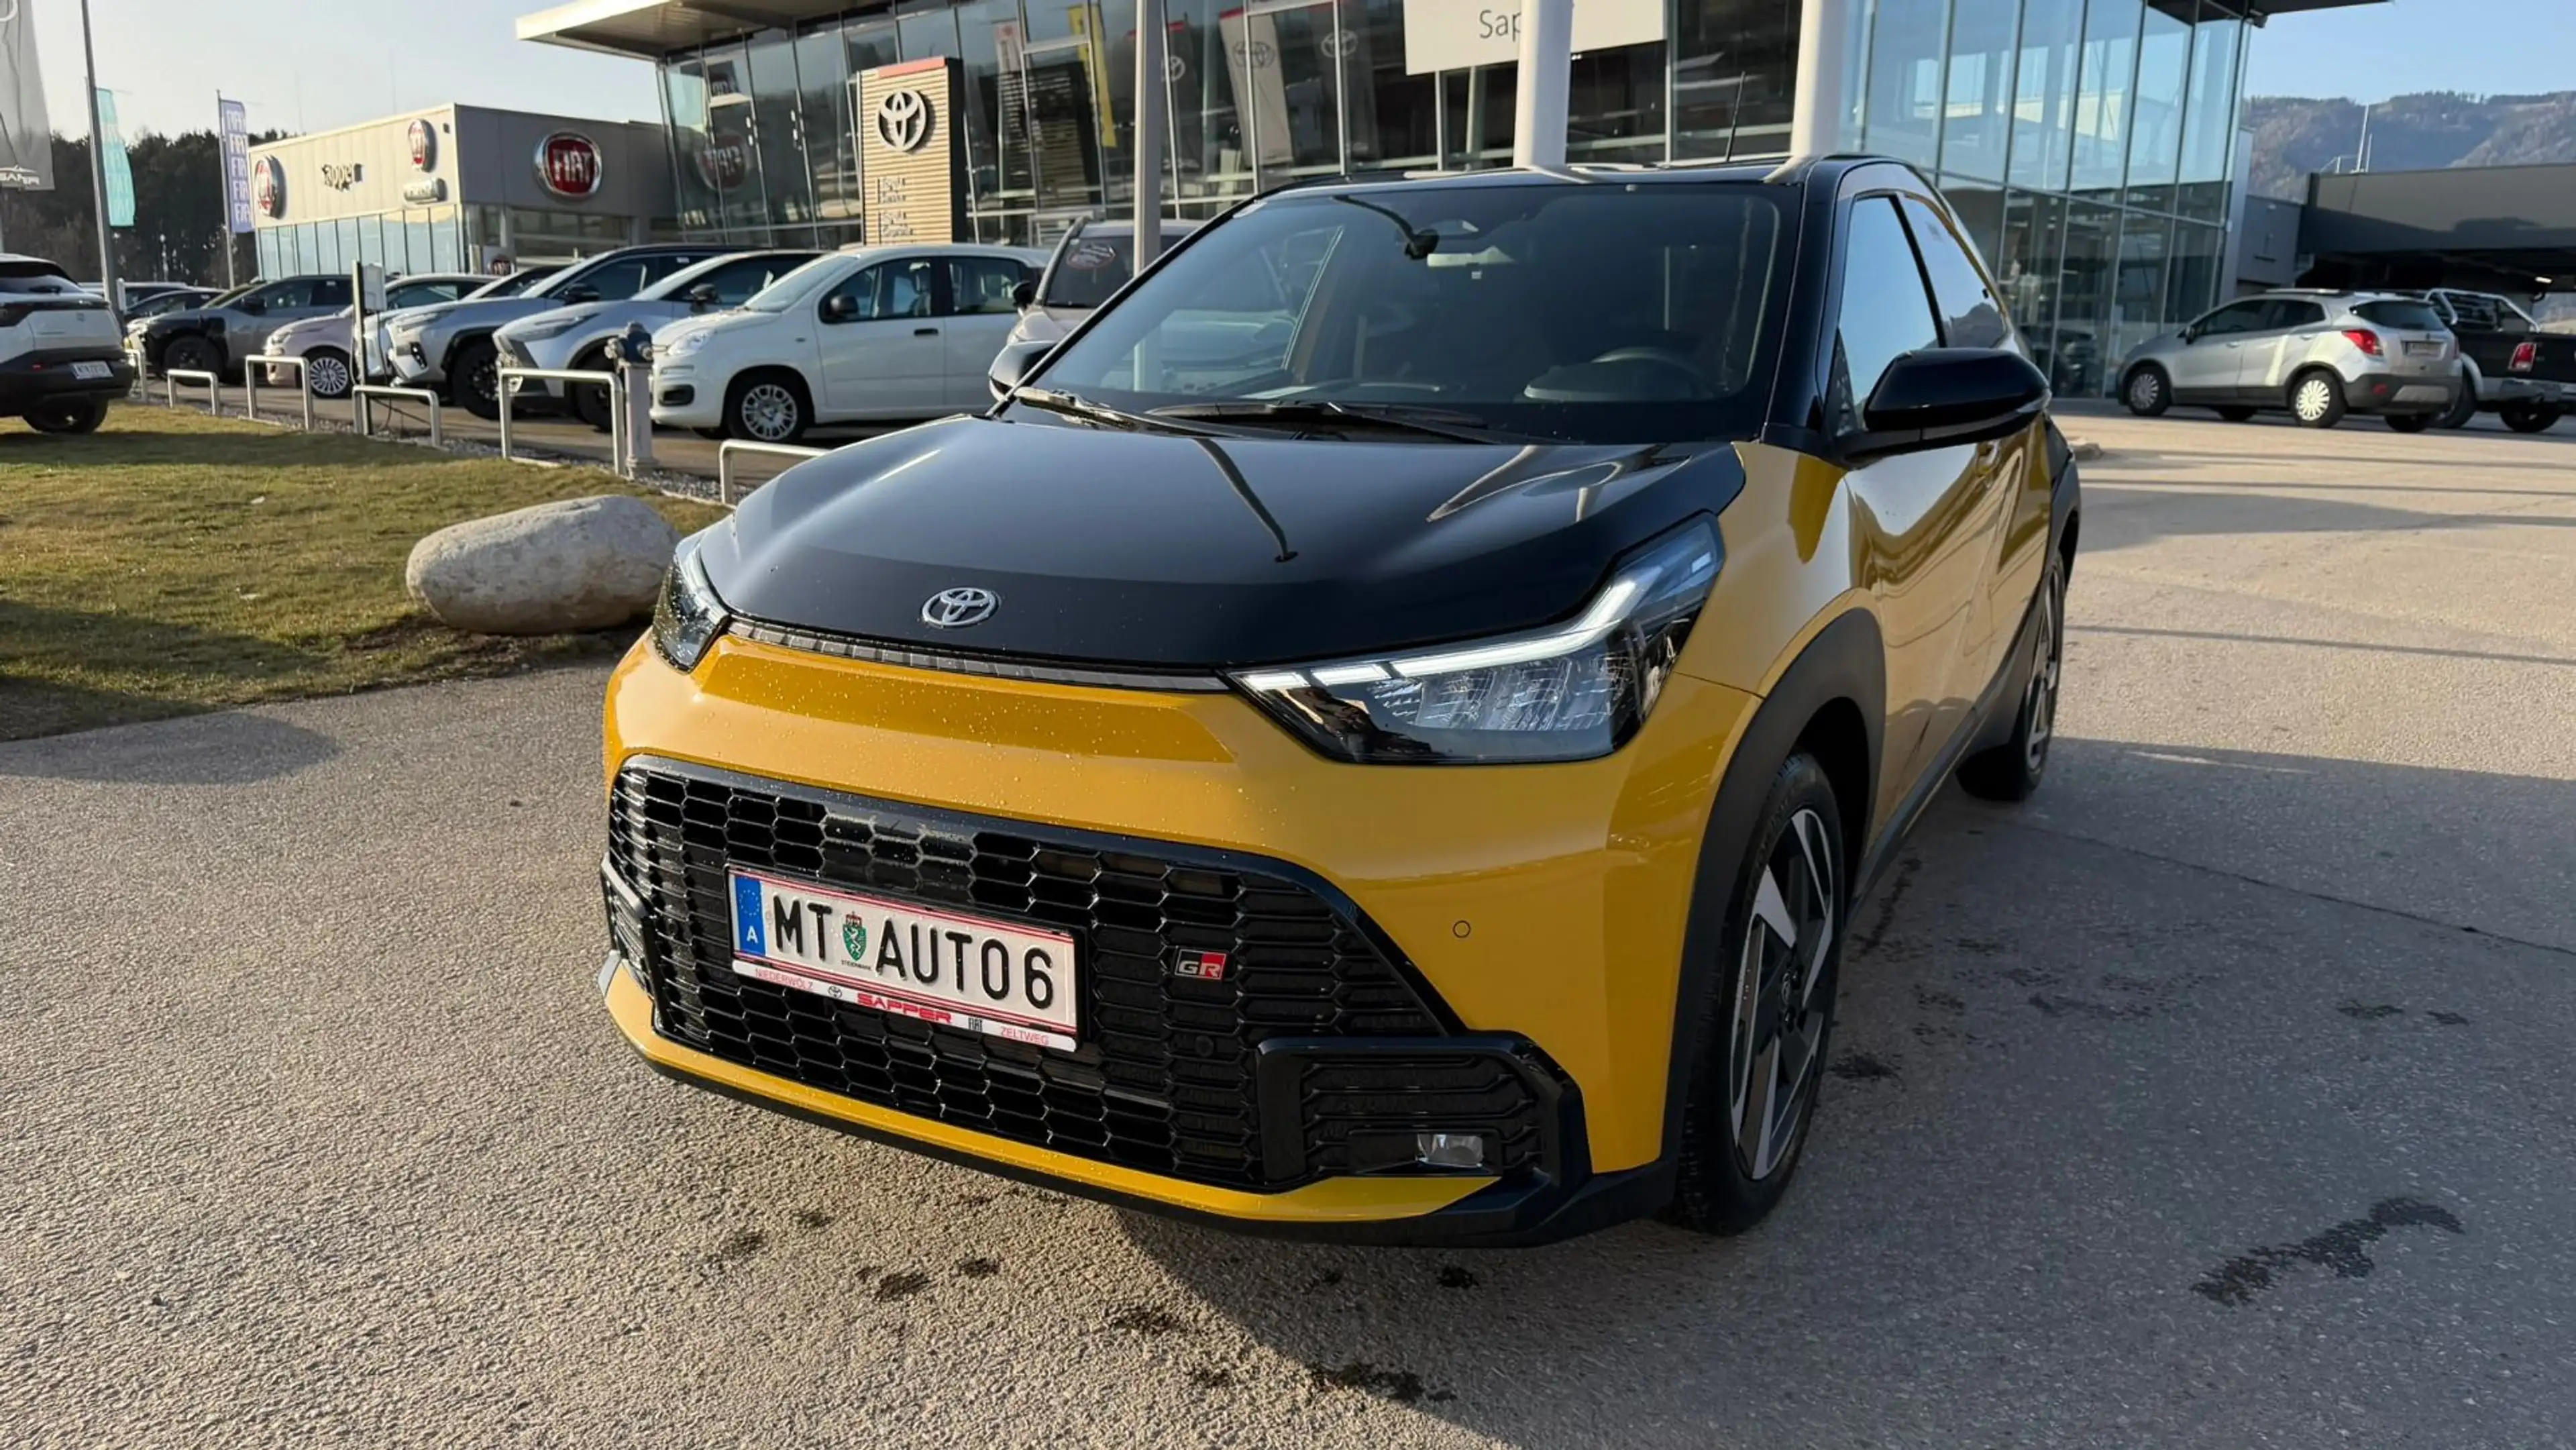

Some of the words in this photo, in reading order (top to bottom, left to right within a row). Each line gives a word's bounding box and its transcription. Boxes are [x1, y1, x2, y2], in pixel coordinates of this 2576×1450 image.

[552, 148, 592, 183] FIAT
[747, 925, 758, 943] A
[773, 895, 833, 962] MT
[1179, 960, 1220, 978] GR
[857, 992, 953, 1024] SAPPER
[1000, 1026, 1050, 1045] ZELTWEG
